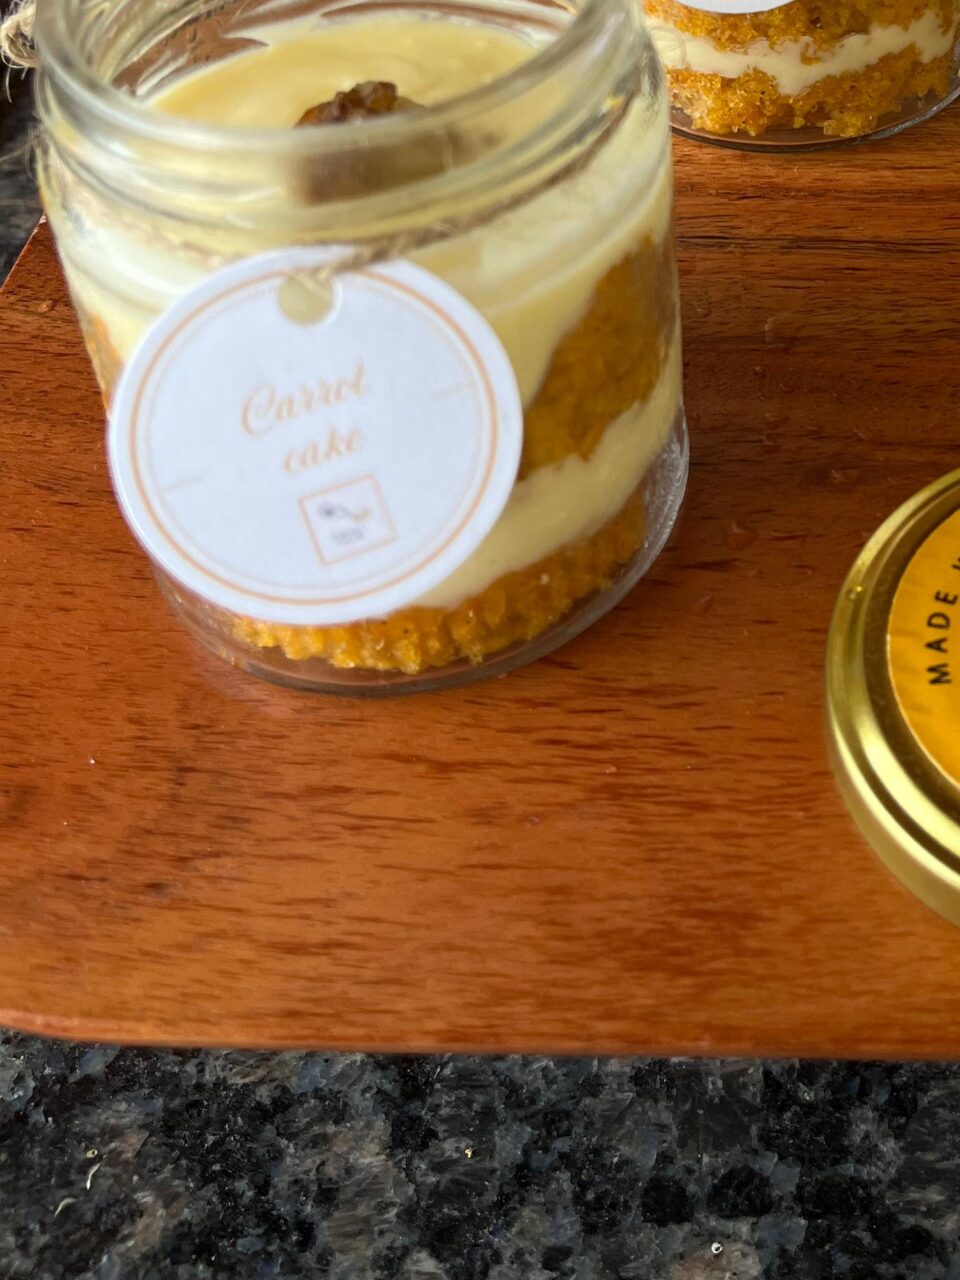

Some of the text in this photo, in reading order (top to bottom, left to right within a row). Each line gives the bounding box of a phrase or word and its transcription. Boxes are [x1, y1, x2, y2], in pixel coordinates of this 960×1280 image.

[240, 359, 368, 437] Carrot
[282, 425, 366, 475] cake
[925, 589, 959, 687] MADE
